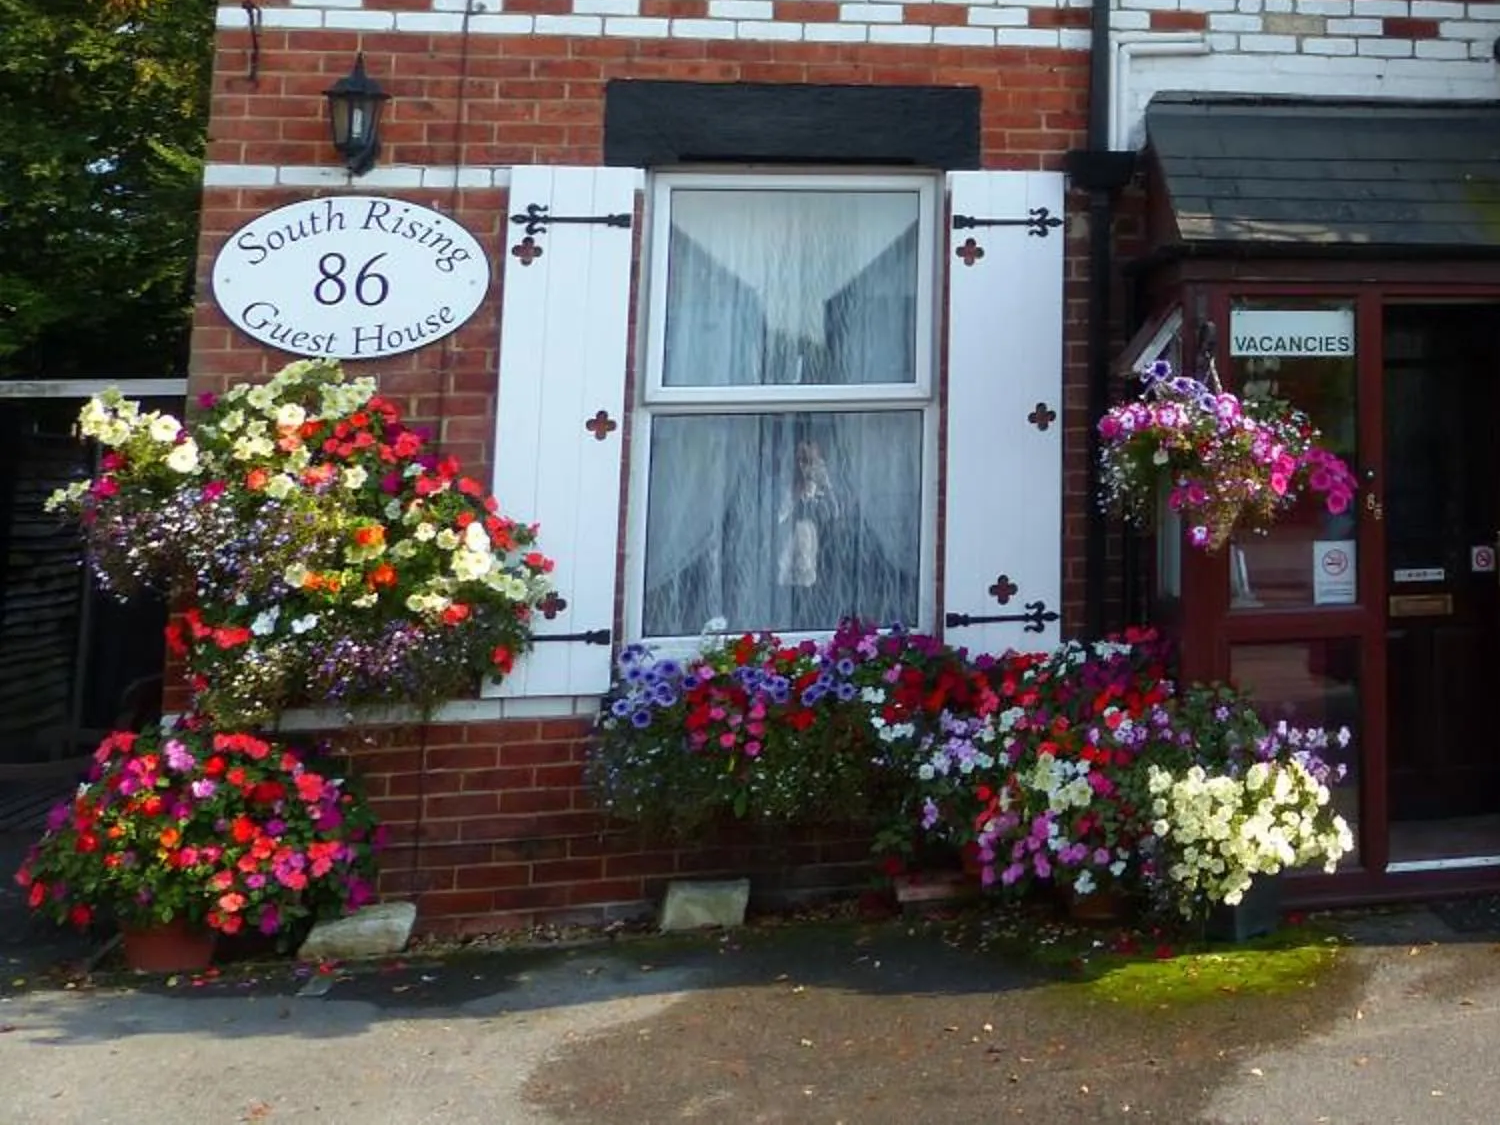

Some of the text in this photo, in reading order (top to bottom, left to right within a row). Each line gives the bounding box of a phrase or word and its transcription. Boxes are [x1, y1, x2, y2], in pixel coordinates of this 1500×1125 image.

[237, 200, 472, 273] South Rising
[314, 252, 389, 306] 86
[241, 302, 457, 355] Guest House
[1235, 335, 1350, 352] VACANCIES
